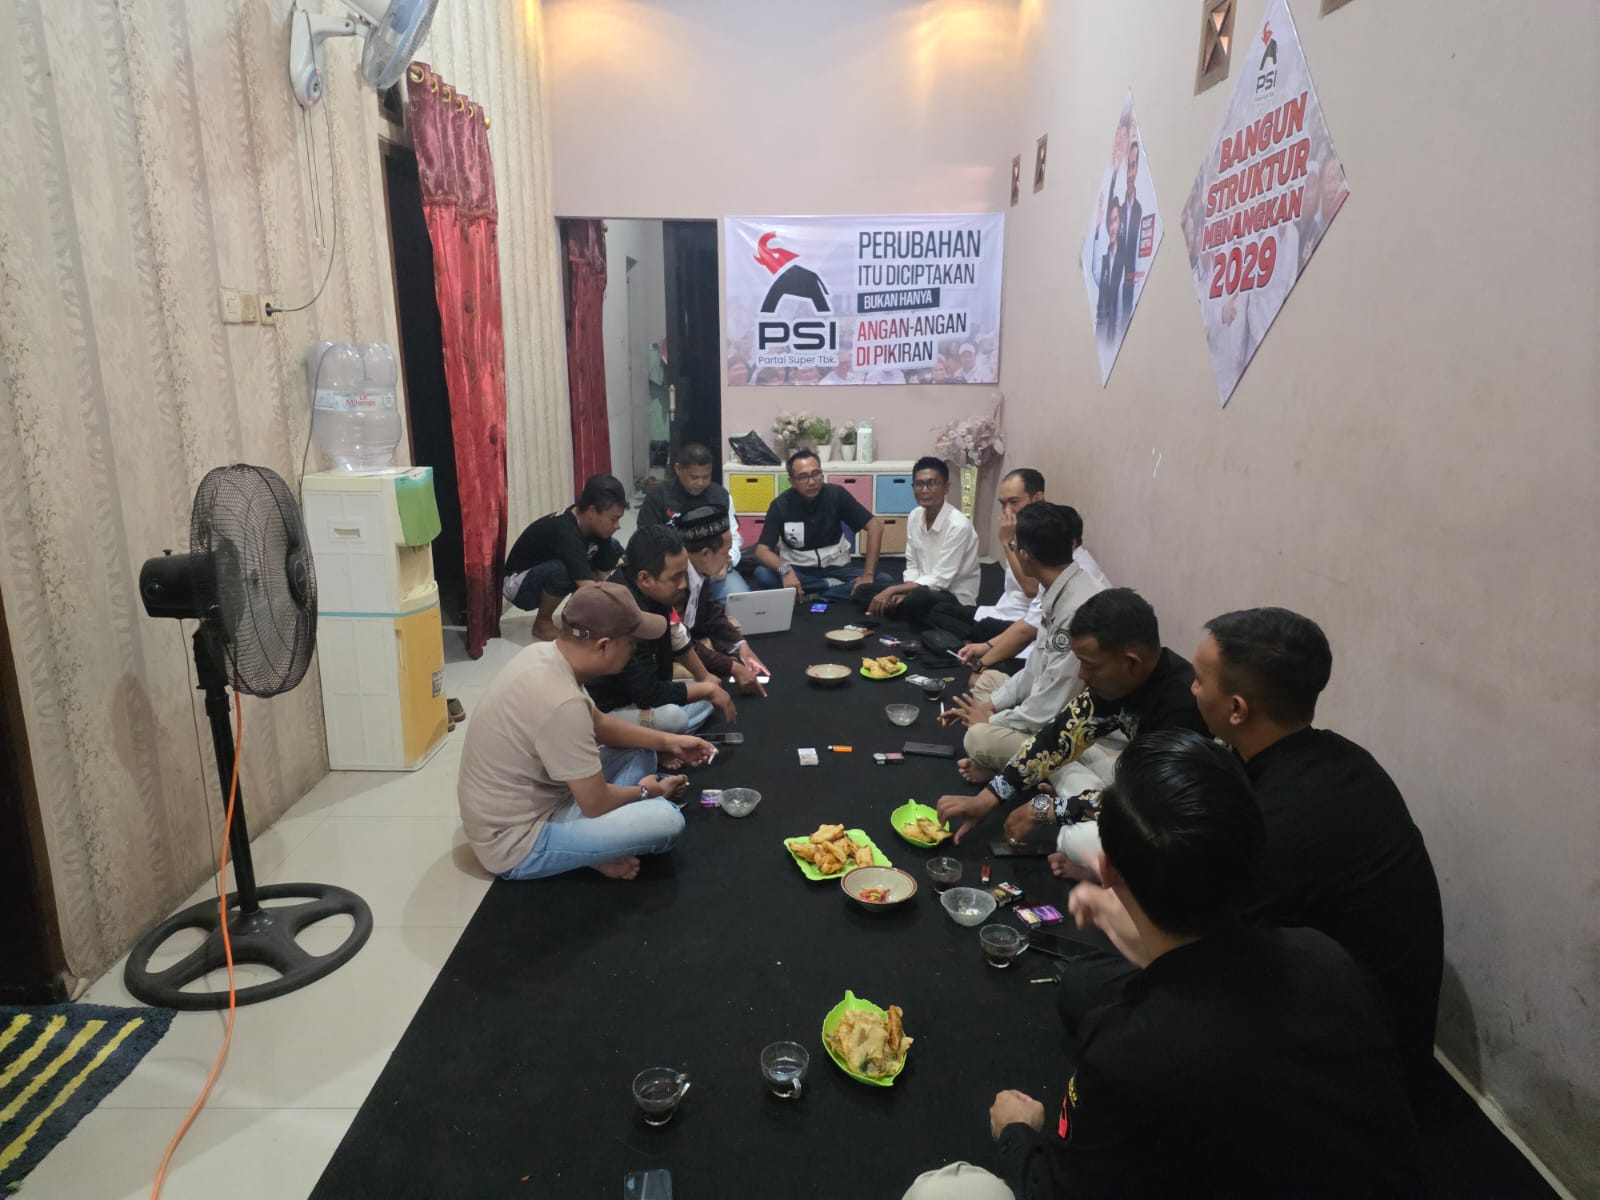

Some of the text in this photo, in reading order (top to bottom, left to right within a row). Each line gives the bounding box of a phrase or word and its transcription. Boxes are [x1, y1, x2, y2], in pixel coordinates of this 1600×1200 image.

[1255, 69, 1277, 94] PSI
[1218, 91, 1308, 174] BANGUN
[1205, 138, 1310, 218] STRUKTUR
[1202, 186, 1305, 251] MENANGKAN
[858, 230, 981, 259] PERUBAHAN
[857, 263, 975, 286] ITU DICIPTAKAN
[1209, 236, 1277, 299] 2029
[864, 289, 932, 309] BUKAN HANYA
[758, 321, 837, 350] PSI
[857, 312, 967, 342] ANGAN-ANGAN
[758, 355, 786, 364] Partai
[788, 355, 815, 367] Super
[856, 341, 933, 367] DI PIKIRAN
